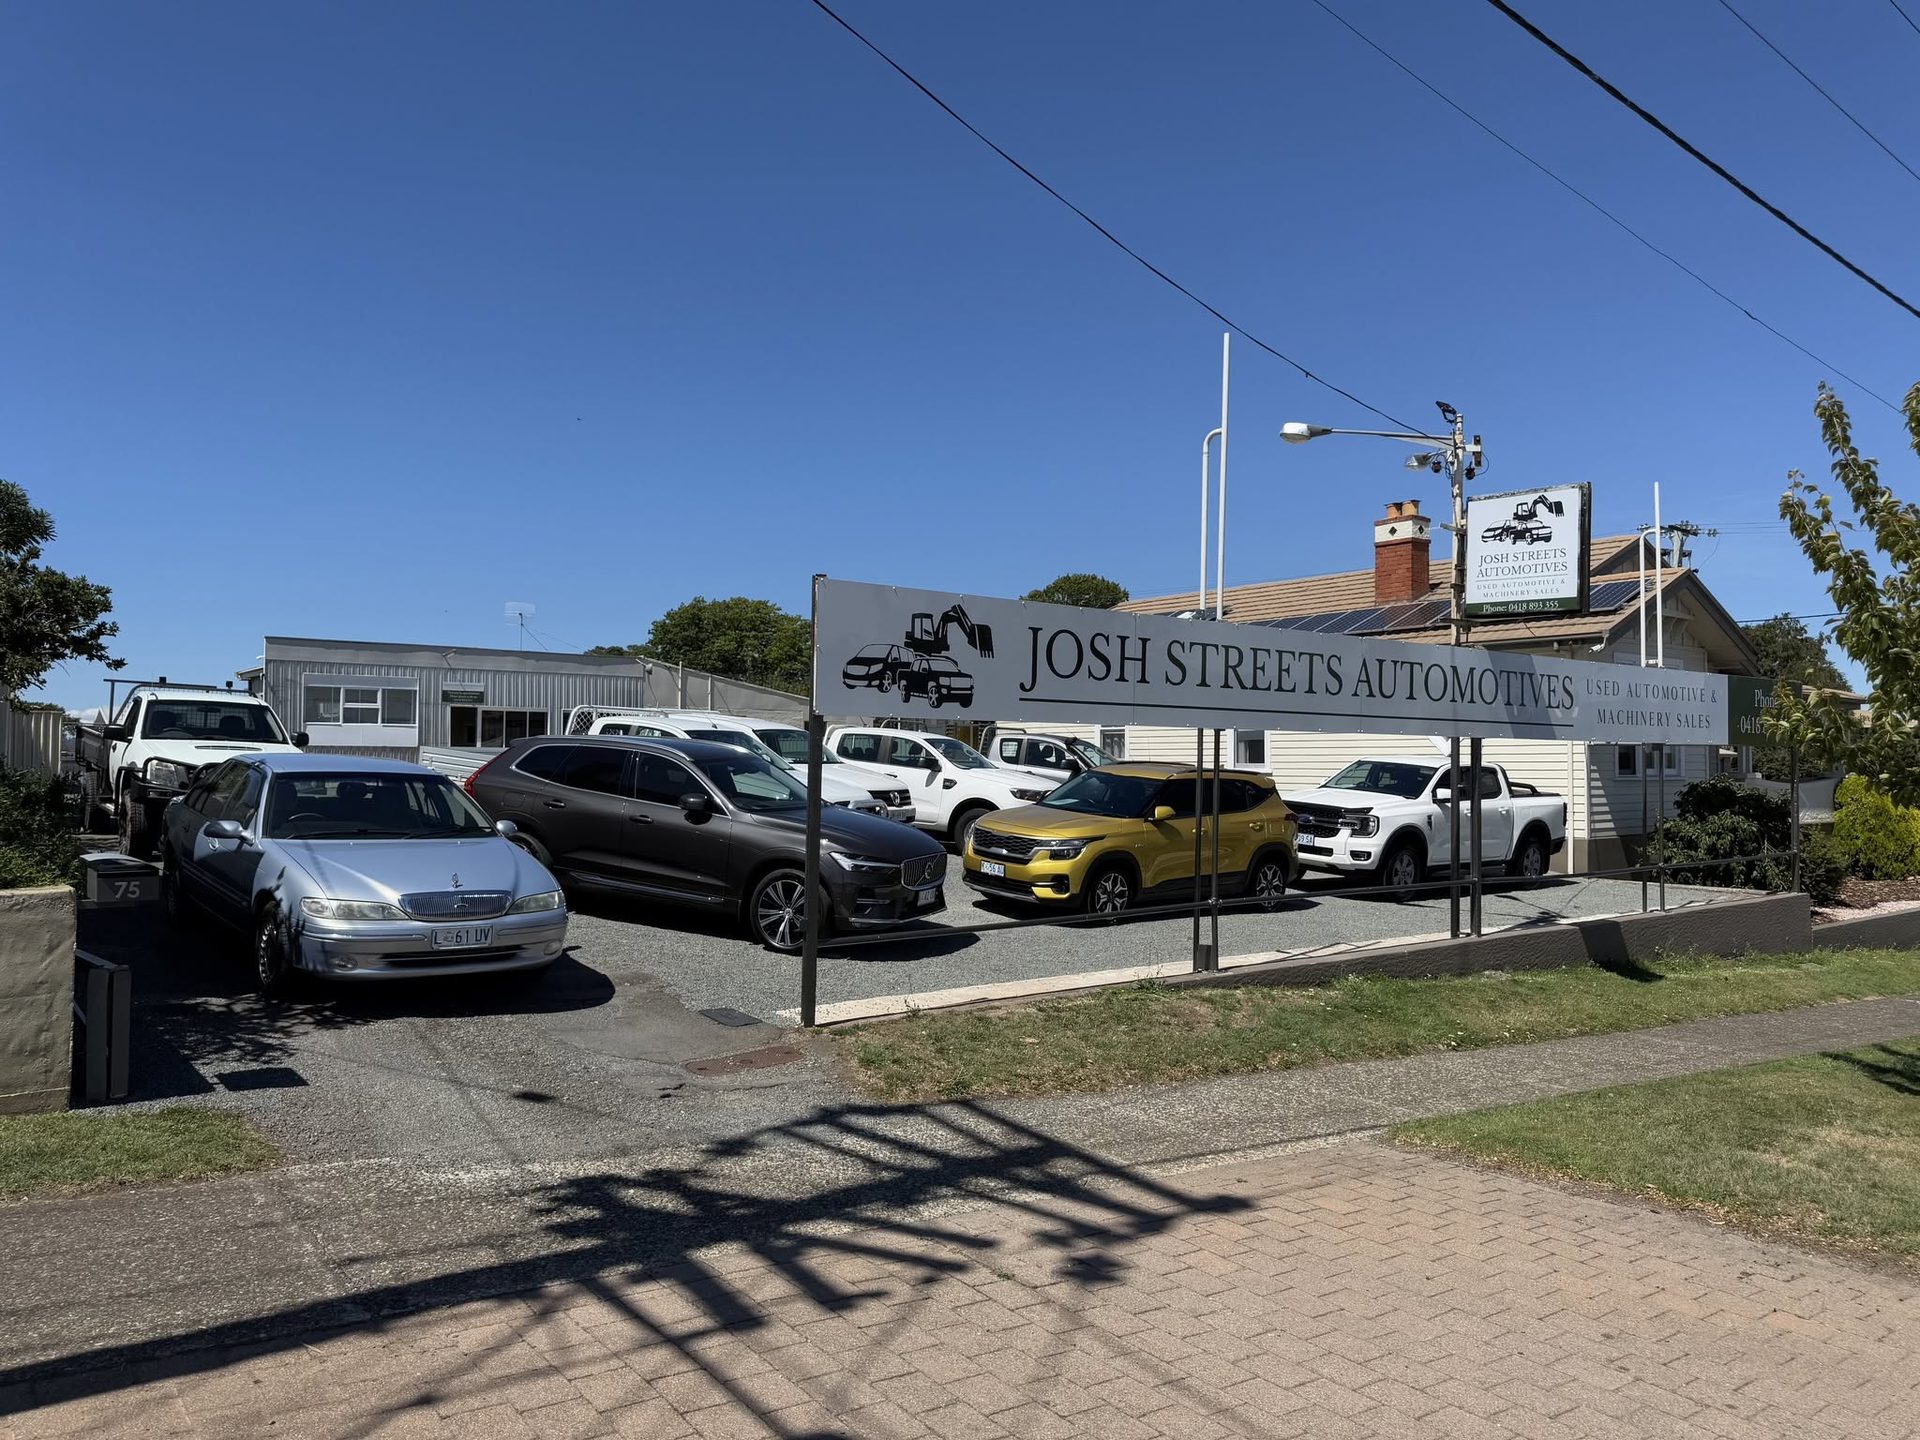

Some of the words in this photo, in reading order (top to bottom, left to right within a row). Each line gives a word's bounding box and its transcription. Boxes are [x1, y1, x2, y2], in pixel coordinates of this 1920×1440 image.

[1478, 552, 1509, 567] JOSH
[1512, 548, 1567, 562] STREETS
[1476, 561, 1568, 578] AUTOMOTIVES
[1483, 589, 1530, 598] MACHINERY
[1534, 587, 1560, 595] SALES
[1502, 579, 1555, 589] AUTOMOTIVE
[1483, 604, 1507, 613] Phone:
[1508, 602, 1527, 612] 0418
[1528, 601, 1543, 610] 893
[1545, 600, 1559, 609] 355
[1018, 626, 1151, 693] JOSH
[1165, 639, 1343, 696] STREETS
[1351, 657, 1574, 710] AUTOMOTIVES
[1586, 678, 1620, 697] USED
[1626, 681, 1706, 703] AUTOMOTIVE
[1710, 689, 1718, 703] &
[1597, 707, 1672, 728] MACHINERY
[1676, 712, 1711, 729] SALES
[114, 881, 140, 898] 75
[434, 931, 442, 945] L
[455, 930, 469, 944] 61
[475, 928, 490, 942] UV
